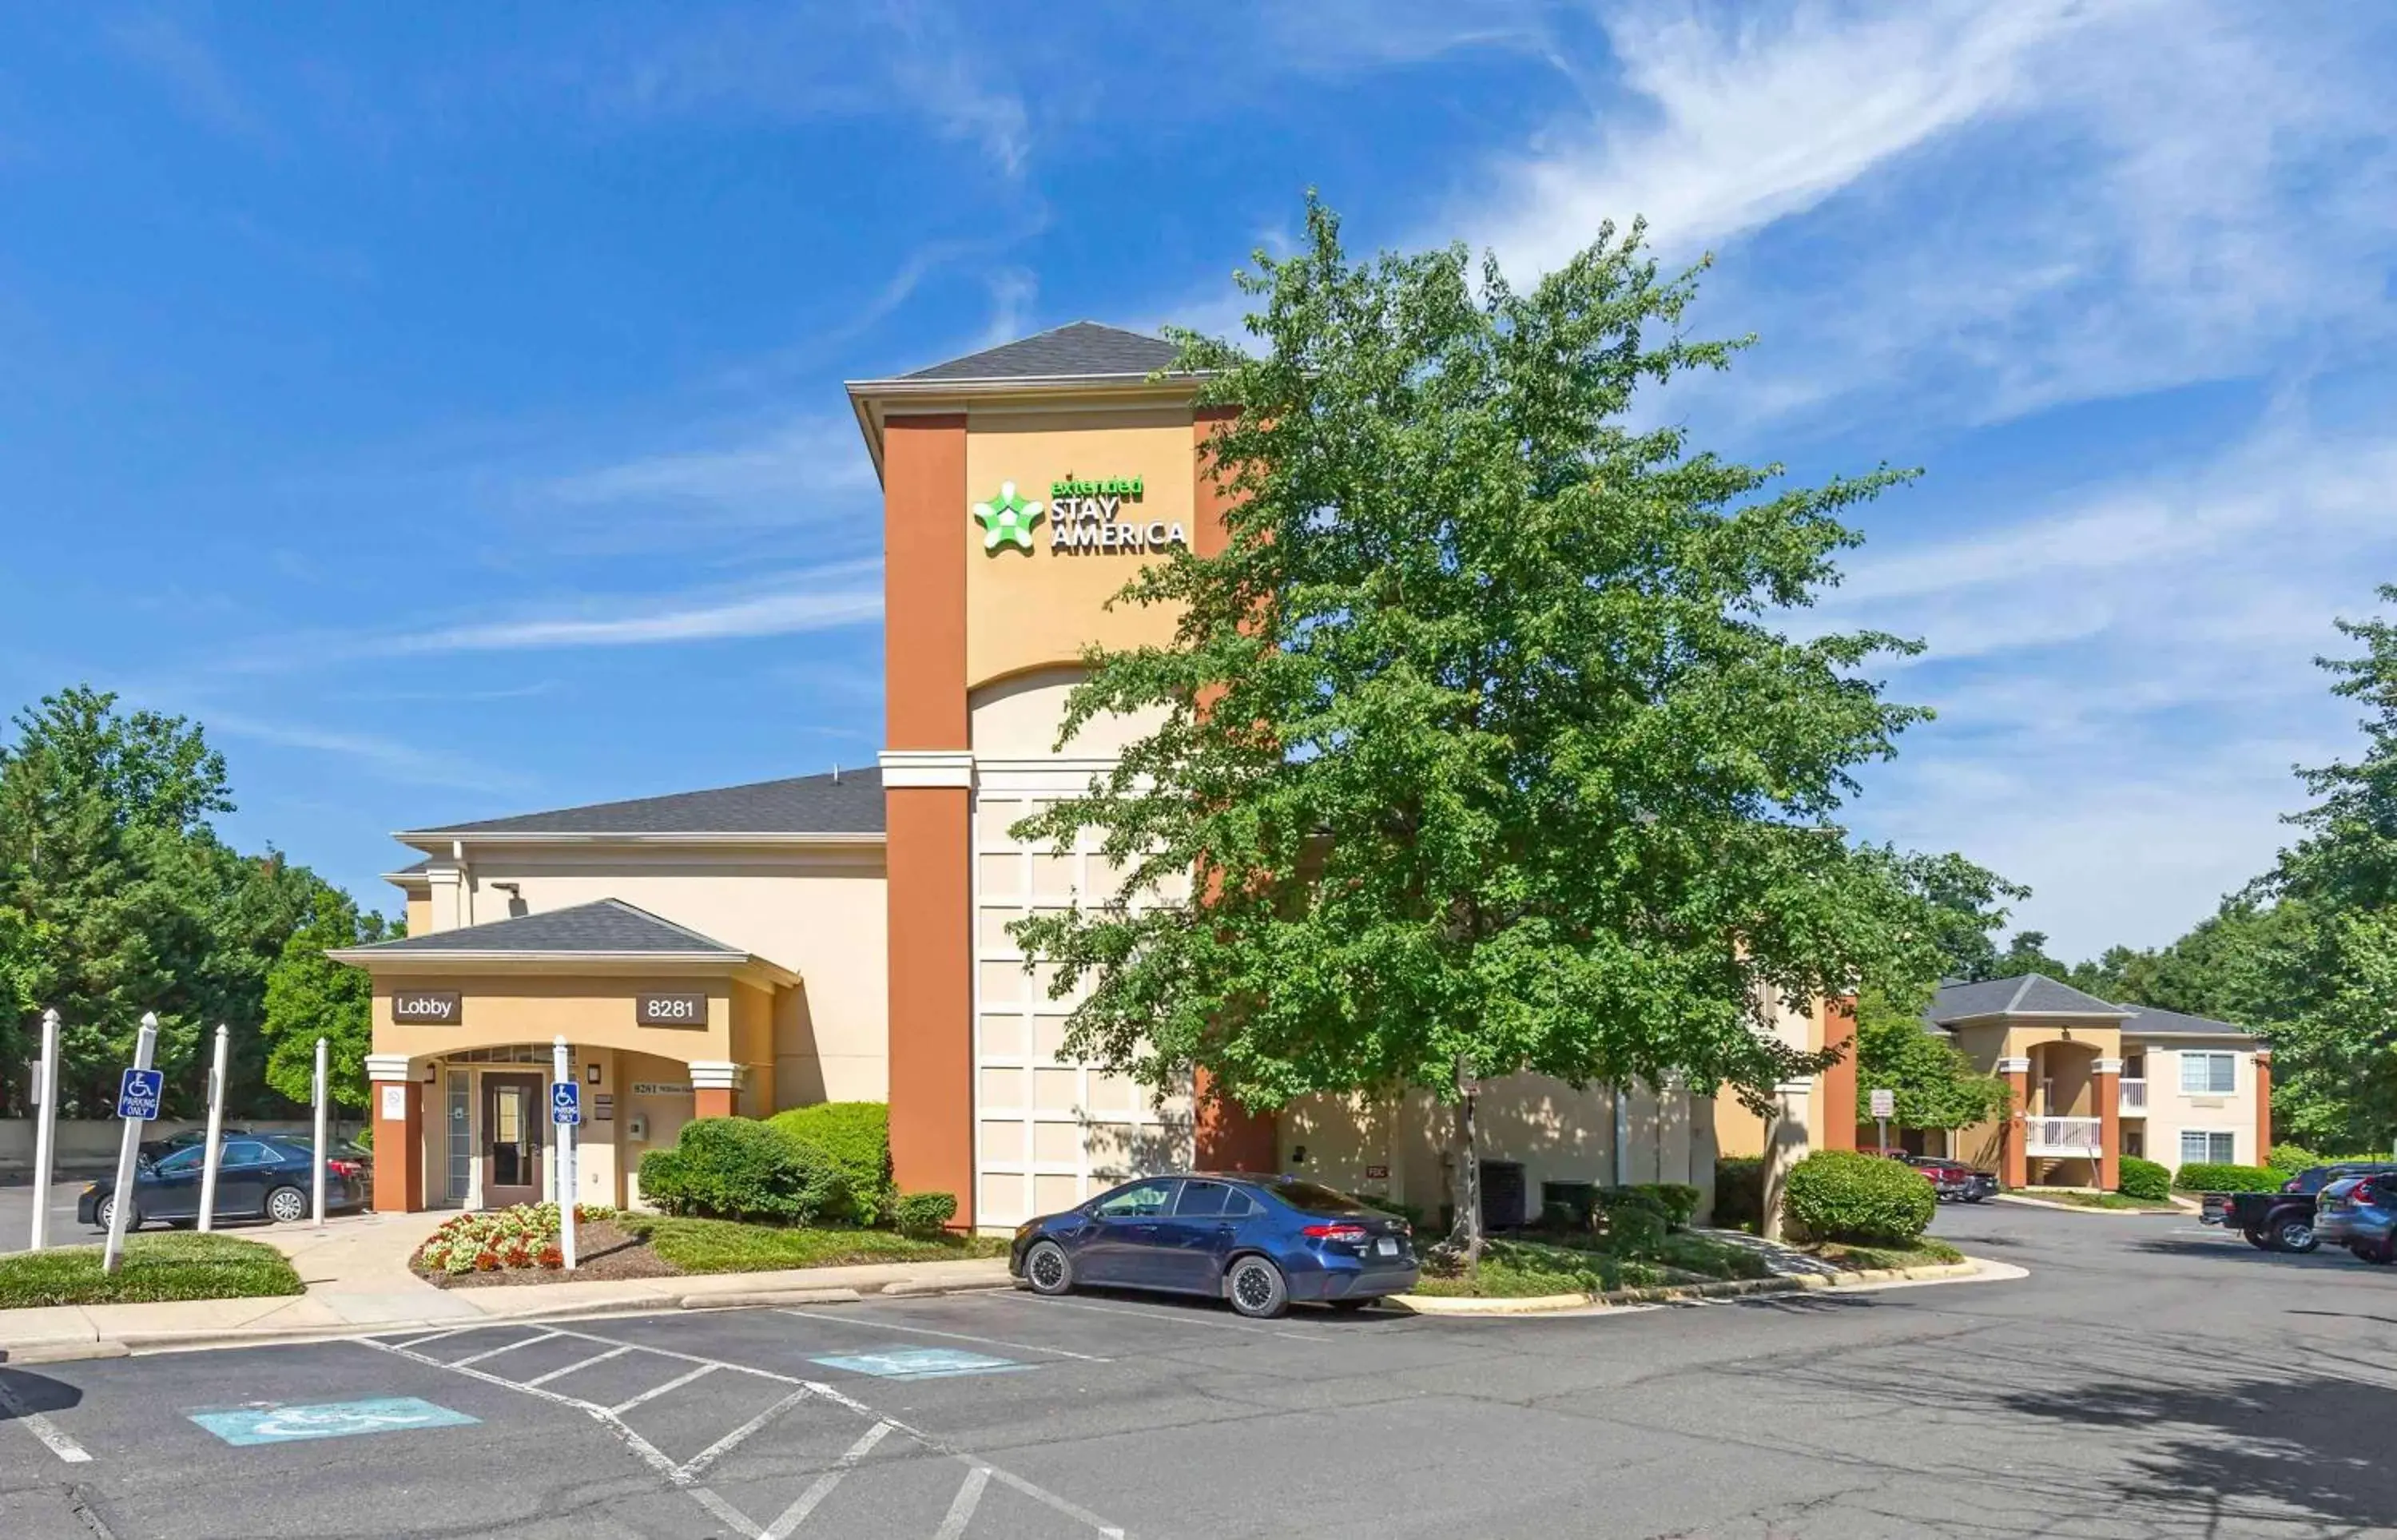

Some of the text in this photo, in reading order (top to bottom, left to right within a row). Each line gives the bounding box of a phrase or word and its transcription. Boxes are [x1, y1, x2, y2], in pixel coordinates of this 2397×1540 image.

[1051, 476, 1142, 495] extended
[1051, 496, 1119, 520] STAY
[1051, 522, 1187, 546] AMERICA
[399, 998, 452, 1018] Lobby
[648, 1000, 693, 1017] 8281
[122, 1096, 156, 1108] PARKING
[128, 1106, 149, 1116] ONLY
